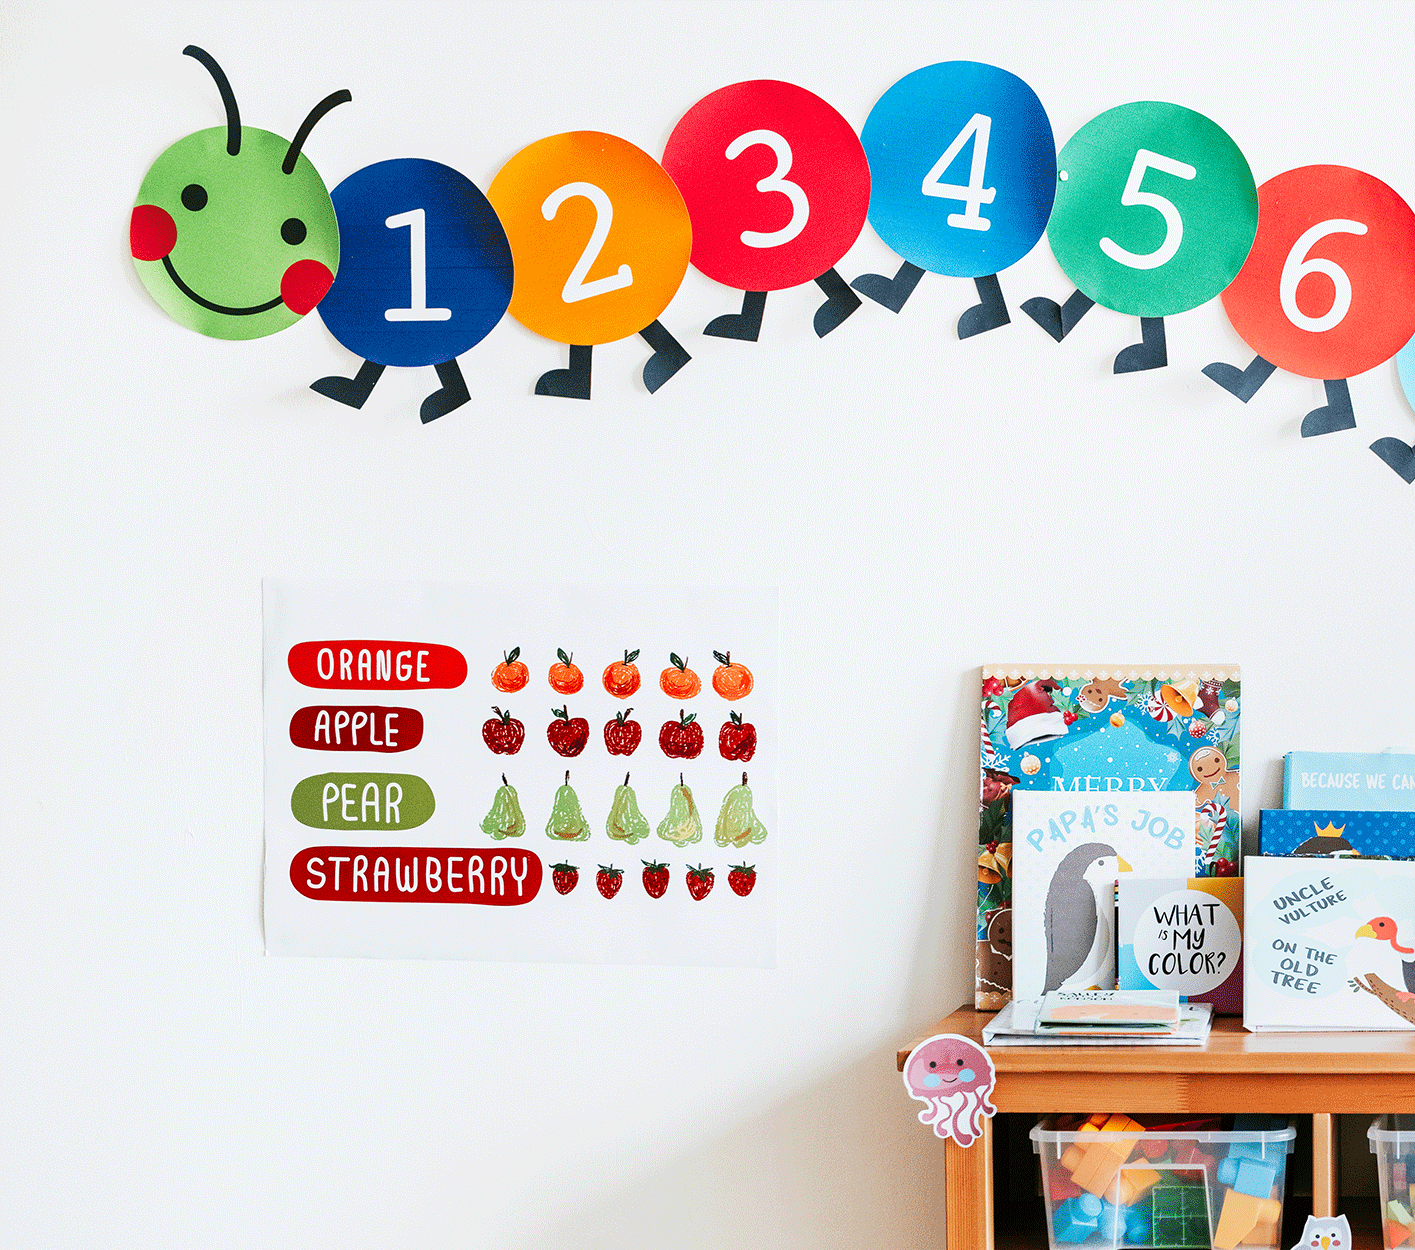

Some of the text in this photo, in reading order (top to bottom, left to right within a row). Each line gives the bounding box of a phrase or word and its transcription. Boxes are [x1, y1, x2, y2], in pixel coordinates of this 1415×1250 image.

[385, 208, 452, 322] 1
[540, 181, 633, 304] 2
[725, 129, 810, 248] 3
[921, 113, 997, 231] 4
[1099, 148, 1197, 270] 5
[1279, 219, 1368, 333] 6
[316, 648, 430, 683] ORANGE
[314, 709, 399, 747] APPLE
[1301, 772, 1361, 789] BECAUSE
[1366, 773, 1387, 789] WE
[322, 782, 403, 824] PEAR
[1026, 804, 1185, 852] PAPA'S JOB
[306, 855, 528, 896] STRAWBERRY
[1273, 876, 1334, 911] UNCLE
[1278, 890, 1347, 924] VULTURE
[1153, 904, 1220, 926] WHAT
[1158, 928, 1205, 950] IS MY
[1272, 939, 1337, 965] ON THE
[1148, 952, 1226, 975] COLOR?
[1280, 958, 1318, 977] OLD
[1271, 970, 1321, 994] TREE
